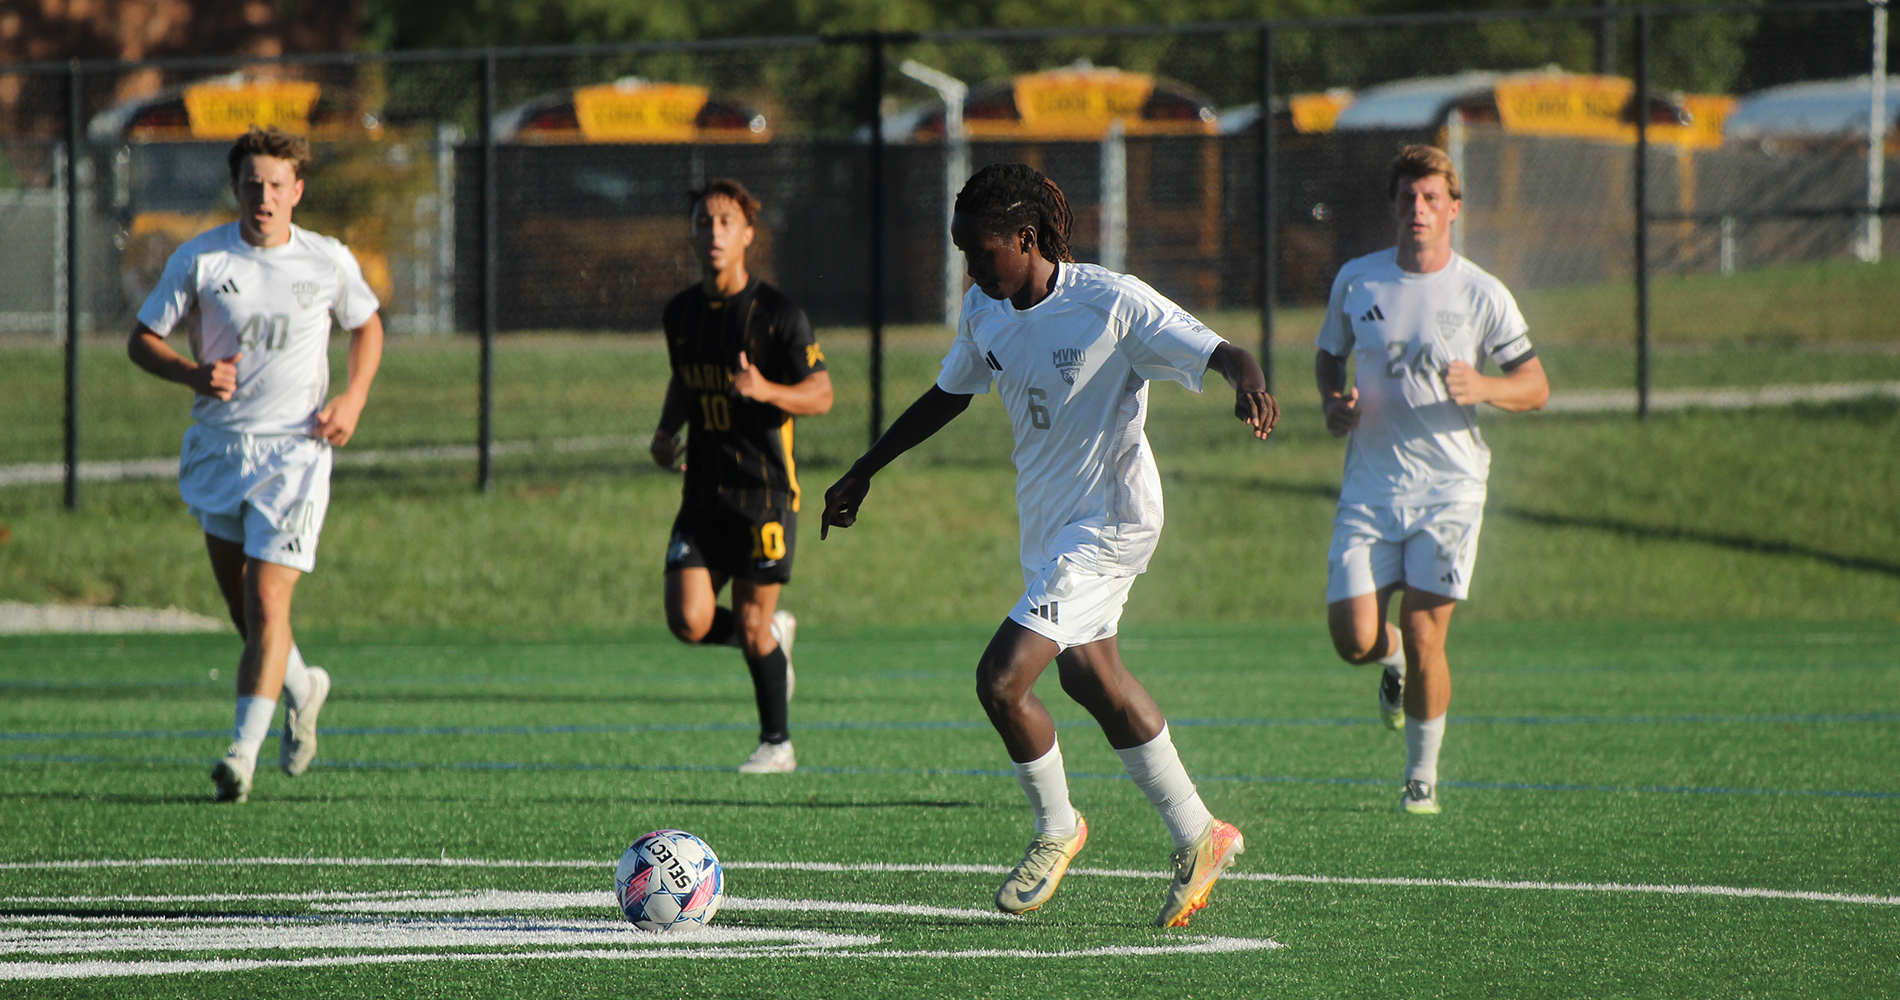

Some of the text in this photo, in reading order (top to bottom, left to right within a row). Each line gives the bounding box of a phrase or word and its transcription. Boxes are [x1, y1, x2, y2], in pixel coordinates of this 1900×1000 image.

[236, 313, 290, 351] 40
[1052, 348, 1086, 364] MVNU
[1385, 341, 1437, 380] 24
[679, 364, 735, 390] MARIA
[701, 394, 731, 431] 10
[1027, 387, 1051, 430] 6
[751, 521, 786, 560] 10
[645, 839, 692, 889] SELECT
